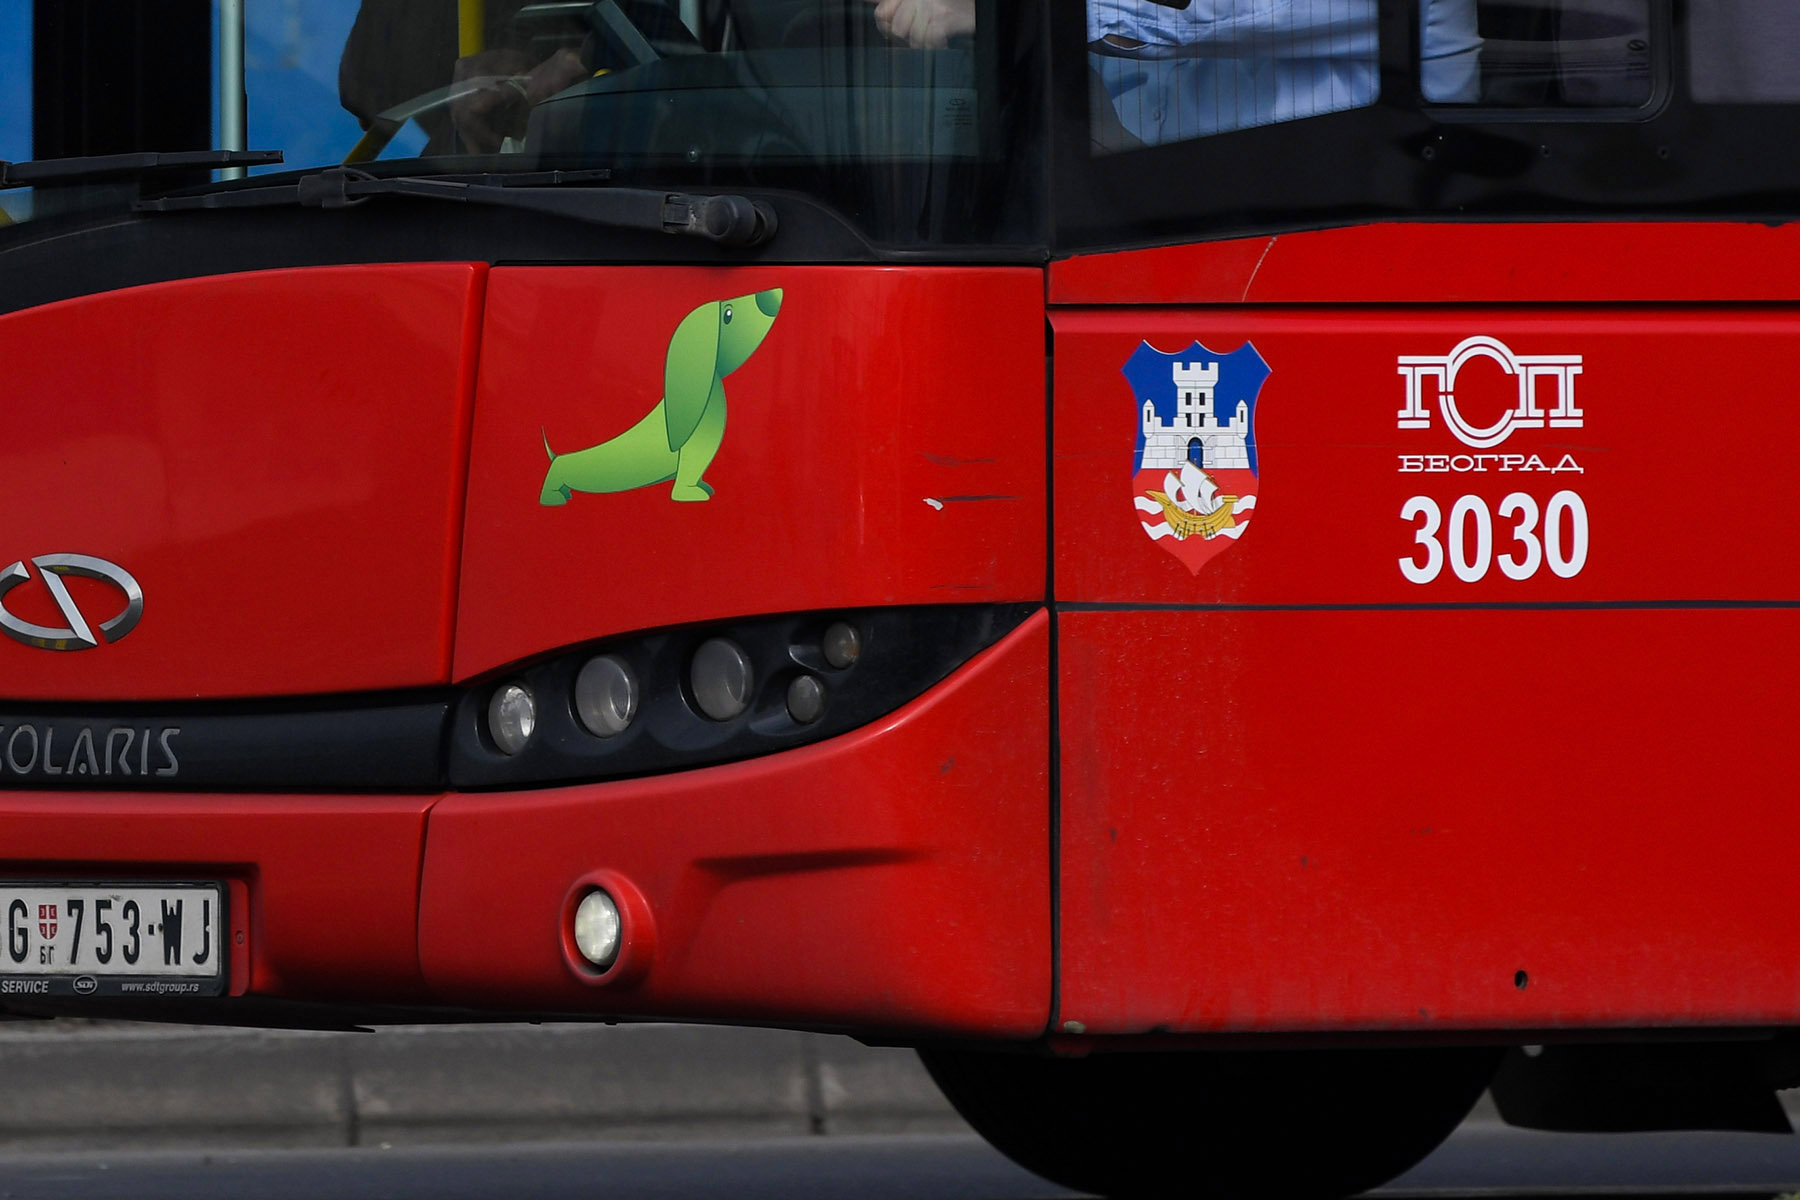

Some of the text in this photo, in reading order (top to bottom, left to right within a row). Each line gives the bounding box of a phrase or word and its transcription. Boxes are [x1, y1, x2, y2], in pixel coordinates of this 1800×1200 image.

[1397, 334, 1584, 449] ГСП
[1397, 454, 1584, 475] БЕОГРАД
[1398, 490, 1590, 585] 3030
[1, 980, 49, 994] SERVICE
[121, 981, 200, 994] www.sdtgroup.rs
